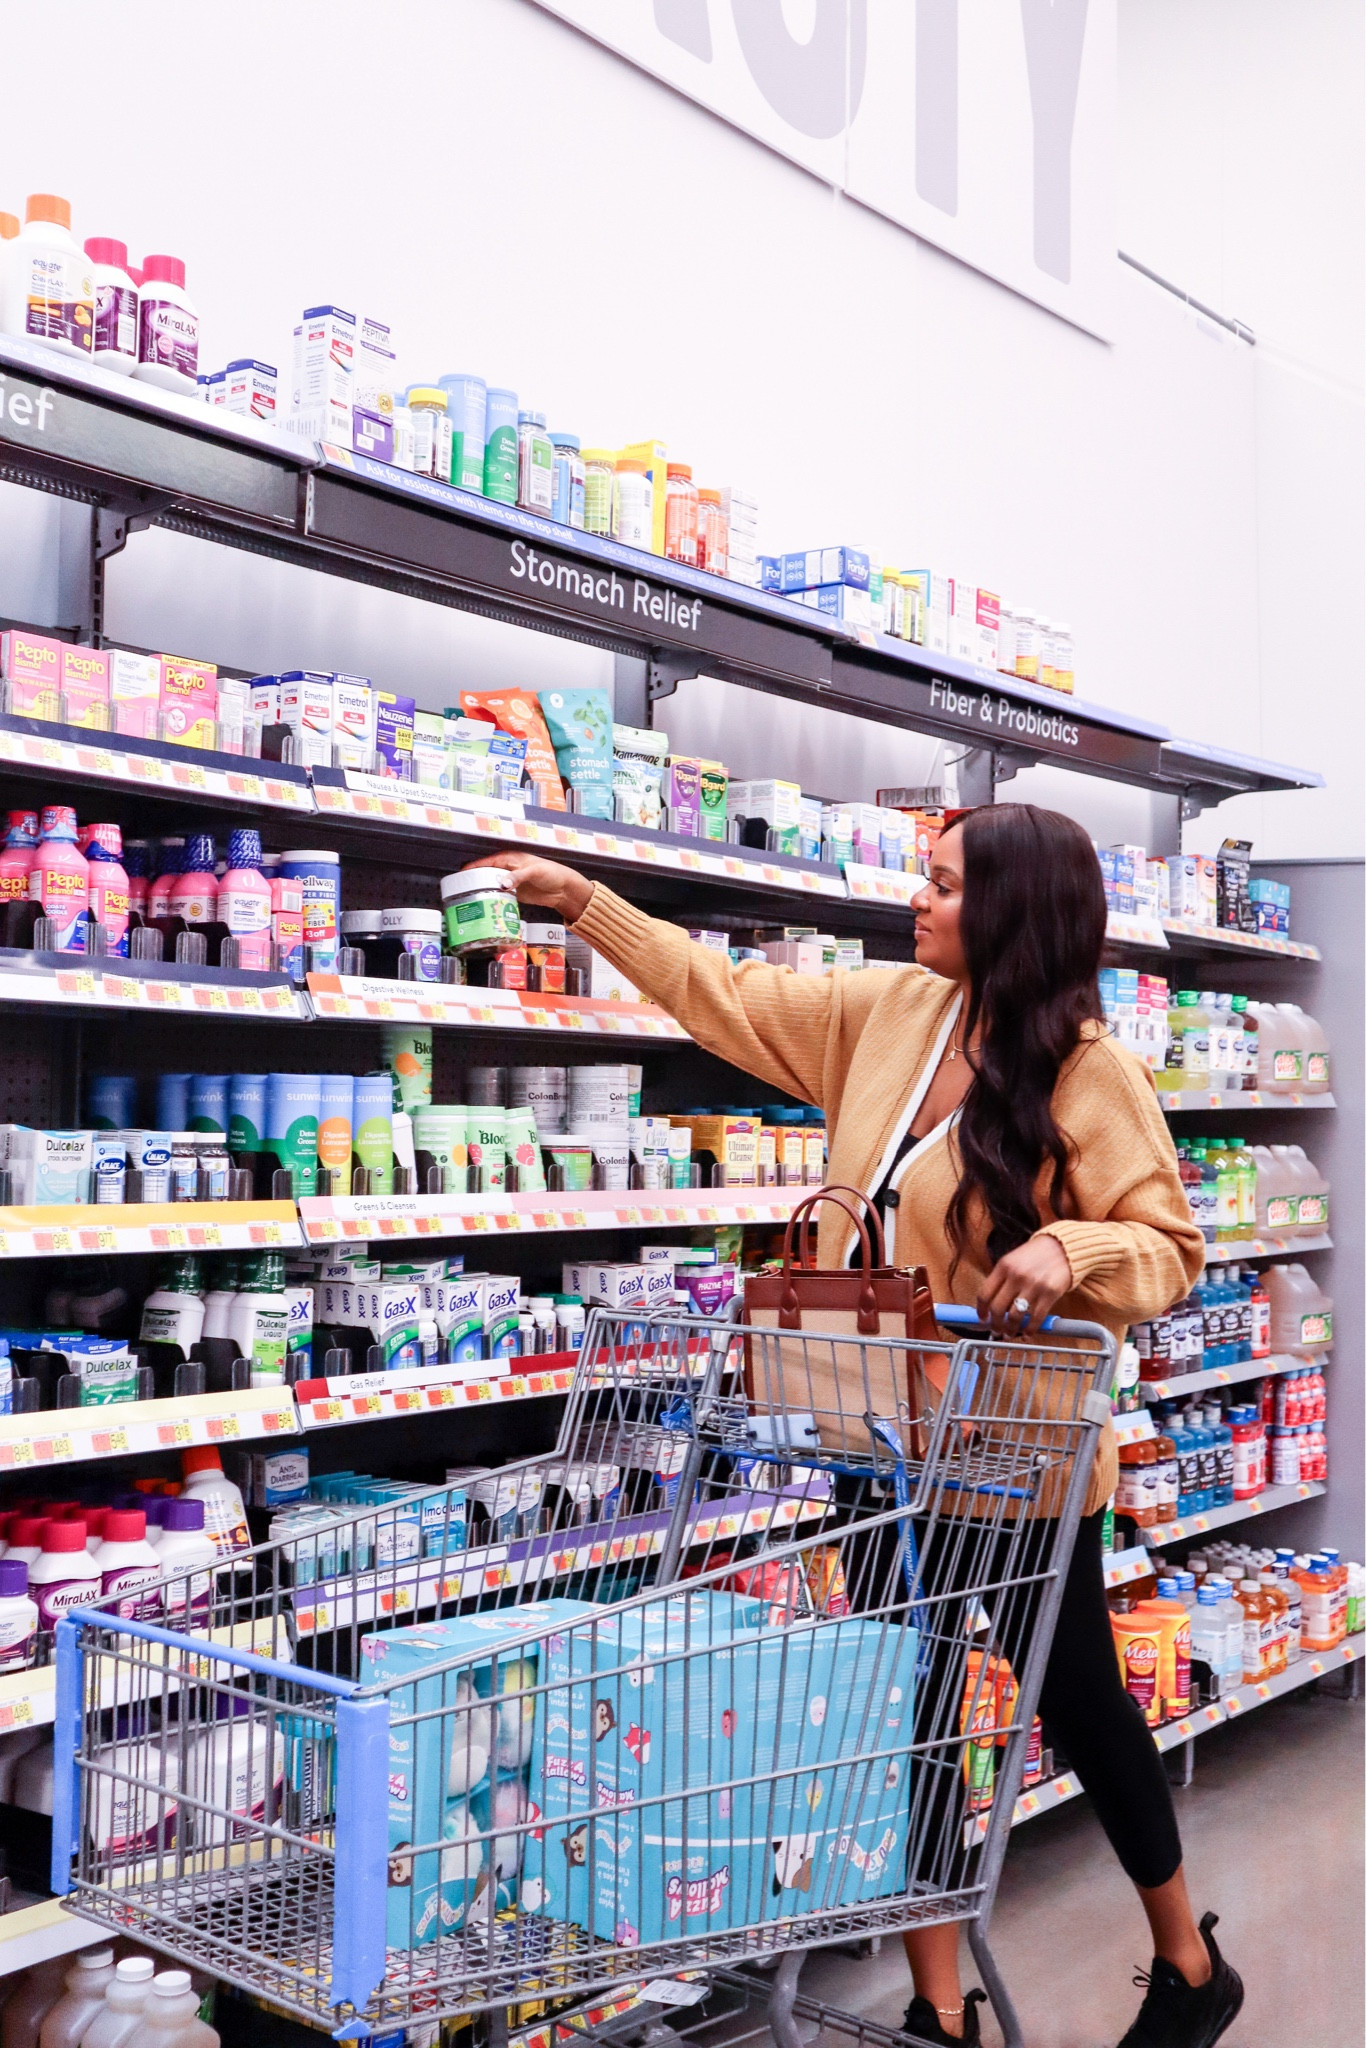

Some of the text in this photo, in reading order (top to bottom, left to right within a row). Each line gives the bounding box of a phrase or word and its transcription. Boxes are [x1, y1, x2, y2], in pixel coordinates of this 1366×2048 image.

[331, 324, 354, 341] Emetrol
[252, 378, 277, 394] Emetrol
[366, 463, 577, 543] Ask for assistance with items on the top shelf.
[510, 540, 624, 608] Stomach
[633, 579, 703, 630] Relief
[15, 639, 57, 664] Pepto
[15, 656, 42, 671] Bismol
[65, 652, 105, 676] Pepto
[65, 668, 91, 682] Bismol
[165, 665, 206, 690] Pepto
[165, 684, 190, 697] Bismol
[304, 690, 330, 702] Emetrol
[338, 693, 369, 708] Emetrol
[378, 707, 413, 725] Nauzene
[930, 678, 976, 717] Fiber
[980, 692, 993, 723] &
[998, 699, 1079, 745] Probiotics
[570, 756, 610, 770] stomach
[570, 768, 601, 781] settle
[366, 779, 449, 802] Nausea & Upset Stomach
[47, 871, 85, 889] Pepto
[47, 887, 74, 896] Bismol
[234, 899, 260, 907] equate
[234, 915, 254, 923] Stomach
[382, 916, 403, 926] OLLY
[314, 930, 325, 938] off
[548, 931, 565, 941] OLLY
[362, 983, 425, 997] Digestive Wellness
[299, 1130, 316, 1138] Detox
[46, 1139, 85, 1152] Dulcolax
[728, 1141, 755, 1152] Ultimate
[729, 1152, 753, 1162] Cleanse
[354, 1201, 417, 1211] Greens & Cleanses
[619, 1275, 644, 1296] Gas-X
[648, 1273, 673, 1292] Gas-X
[698, 1280, 722, 1291] PHAZYME
[449, 1290, 479, 1312] Gas-X
[488, 1288, 517, 1310] Gas-X
[384, 1296, 417, 1319] Gas-X
[257, 1319, 287, 1330] Dulcolax
[454, 1323, 469, 1336] EXTRA
[390, 1332, 406, 1346] EXTRA
[86, 1359, 132, 1374] Dulcolax
[350, 1377, 385, 1390] Gas Relief
[278, 1464, 296, 1474] ANTI-
[424, 1503, 464, 1517] Imodum
[53, 1590, 97, 1608] MiraLAX
